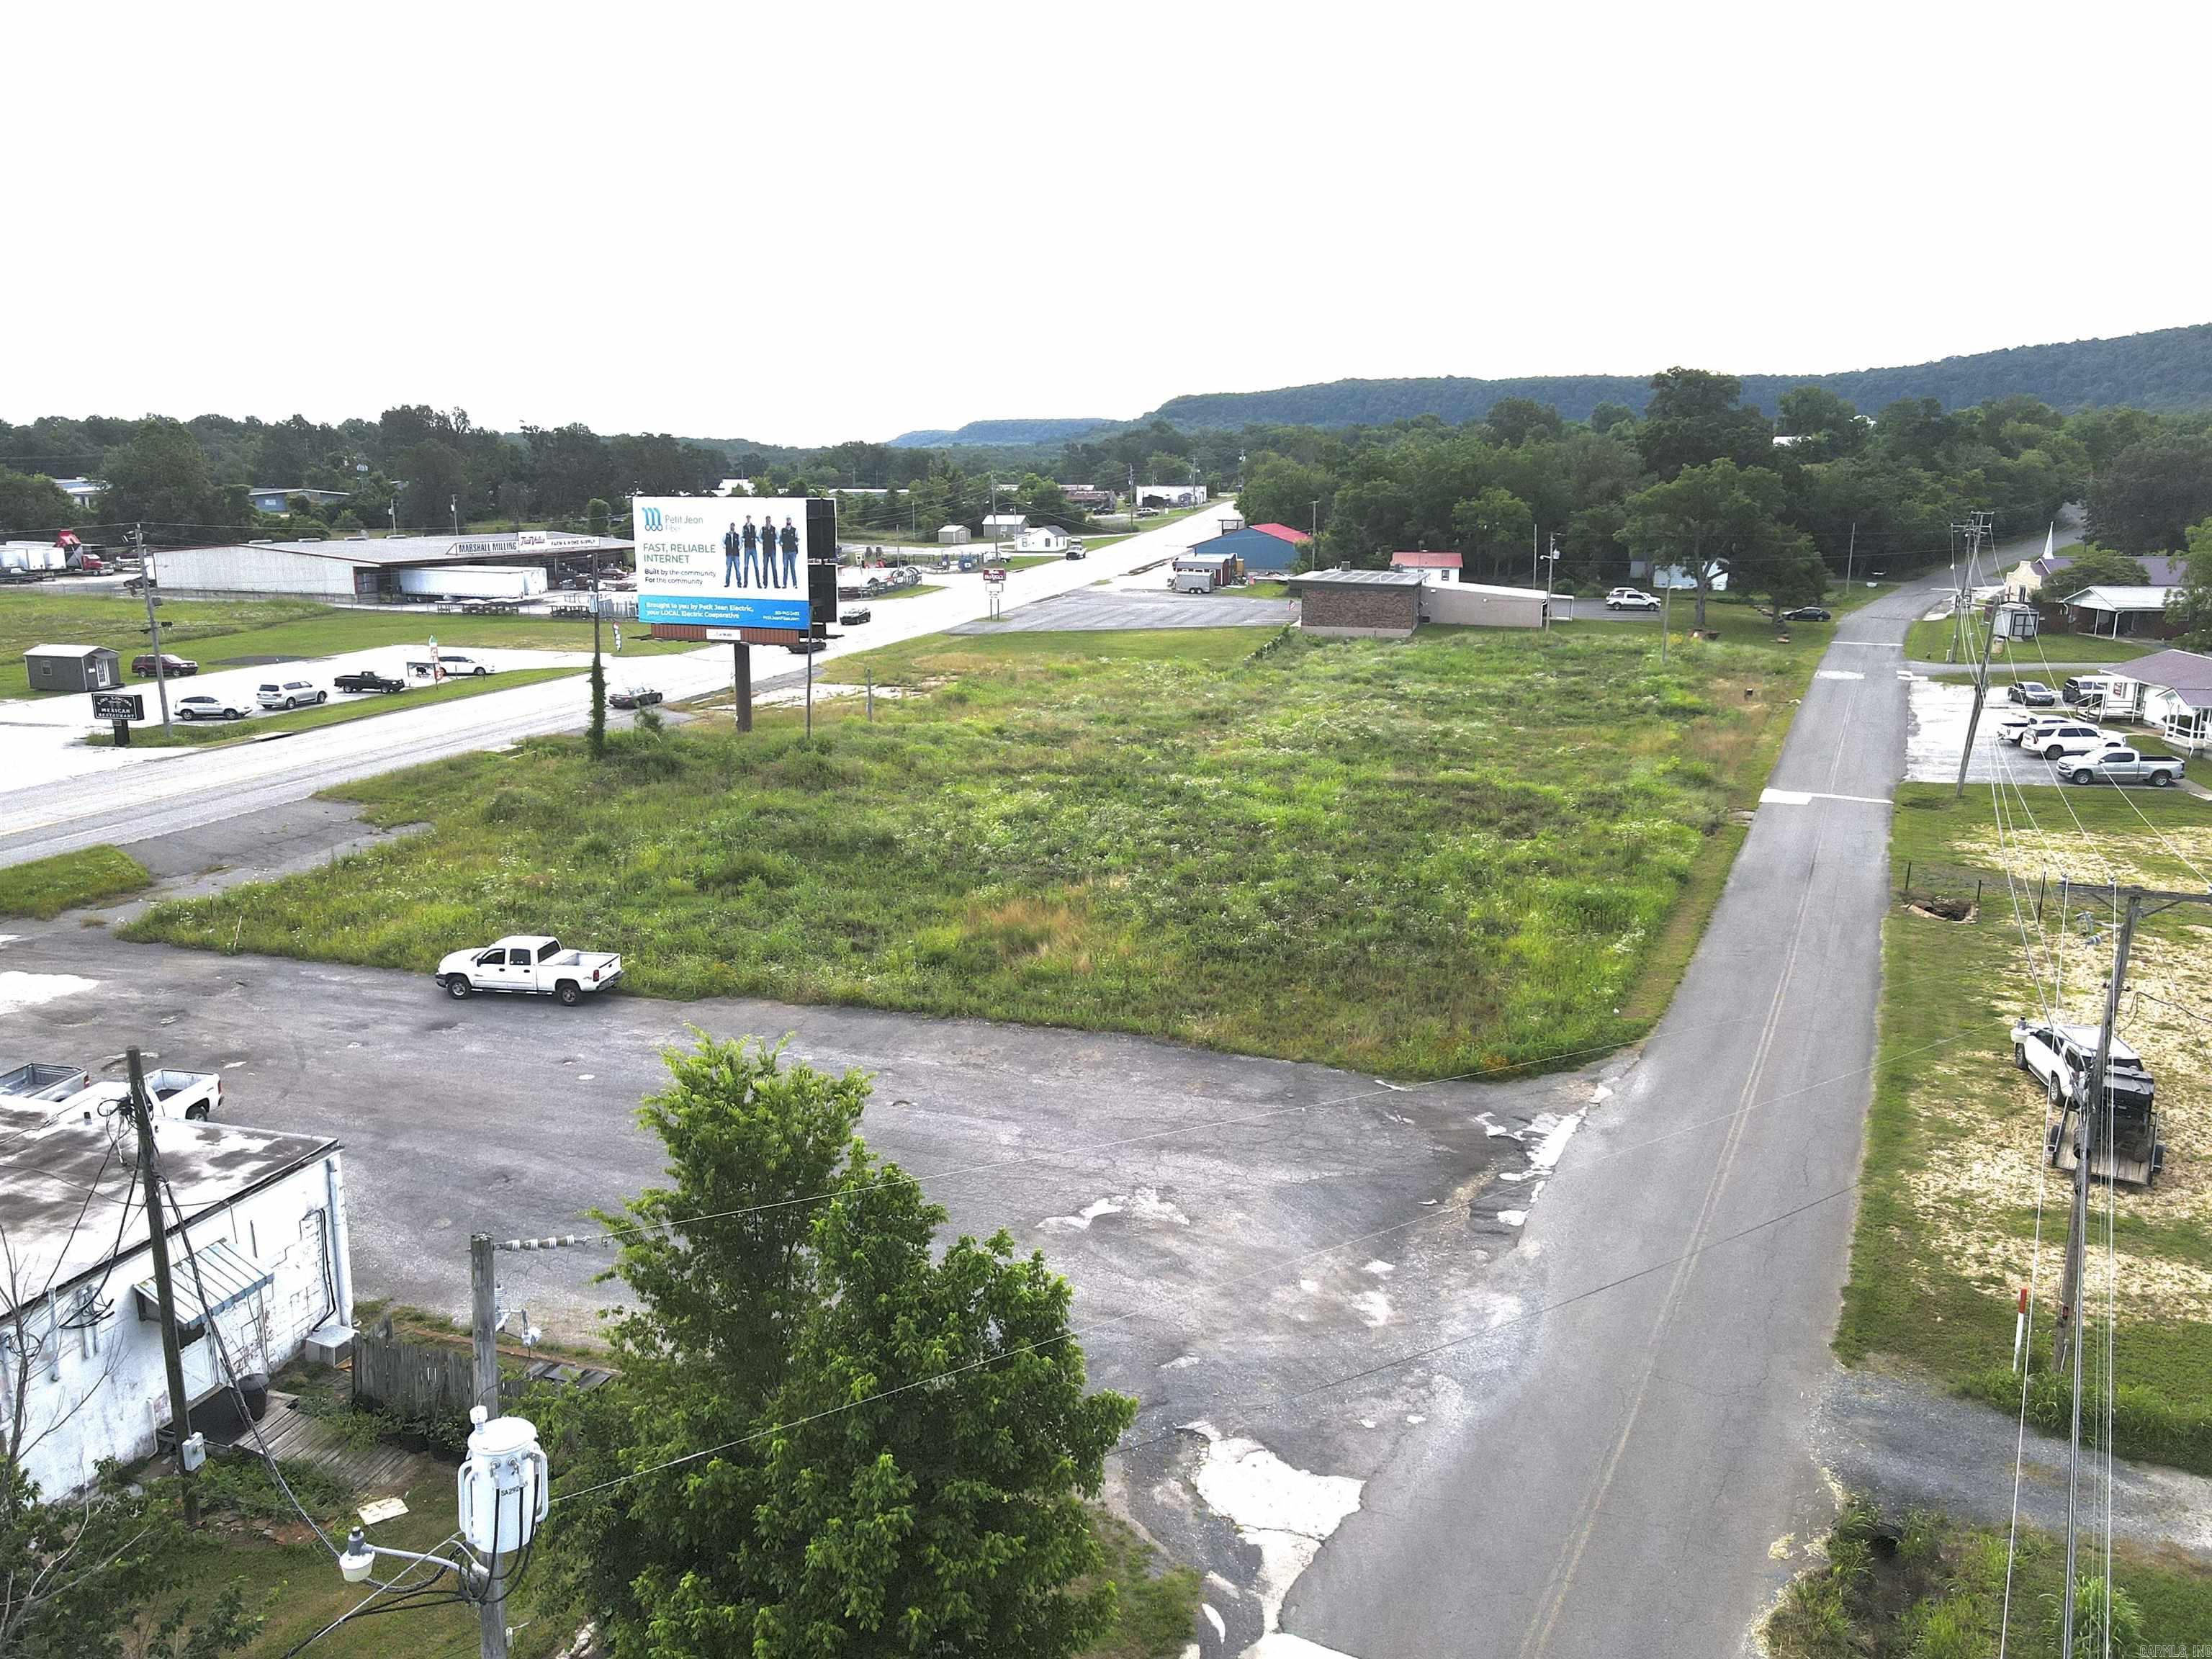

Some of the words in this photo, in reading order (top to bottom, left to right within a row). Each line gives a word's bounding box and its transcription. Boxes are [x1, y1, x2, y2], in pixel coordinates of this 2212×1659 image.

[684, 515, 703, 524] Jean
[459, 543, 490, 553] MARSHALL
[493, 541, 517, 551] MILLING
[643, 543, 668, 554] FAST,
[670, 544, 716, 554] RELIABLE
[644, 554, 690, 564] INTERNET
